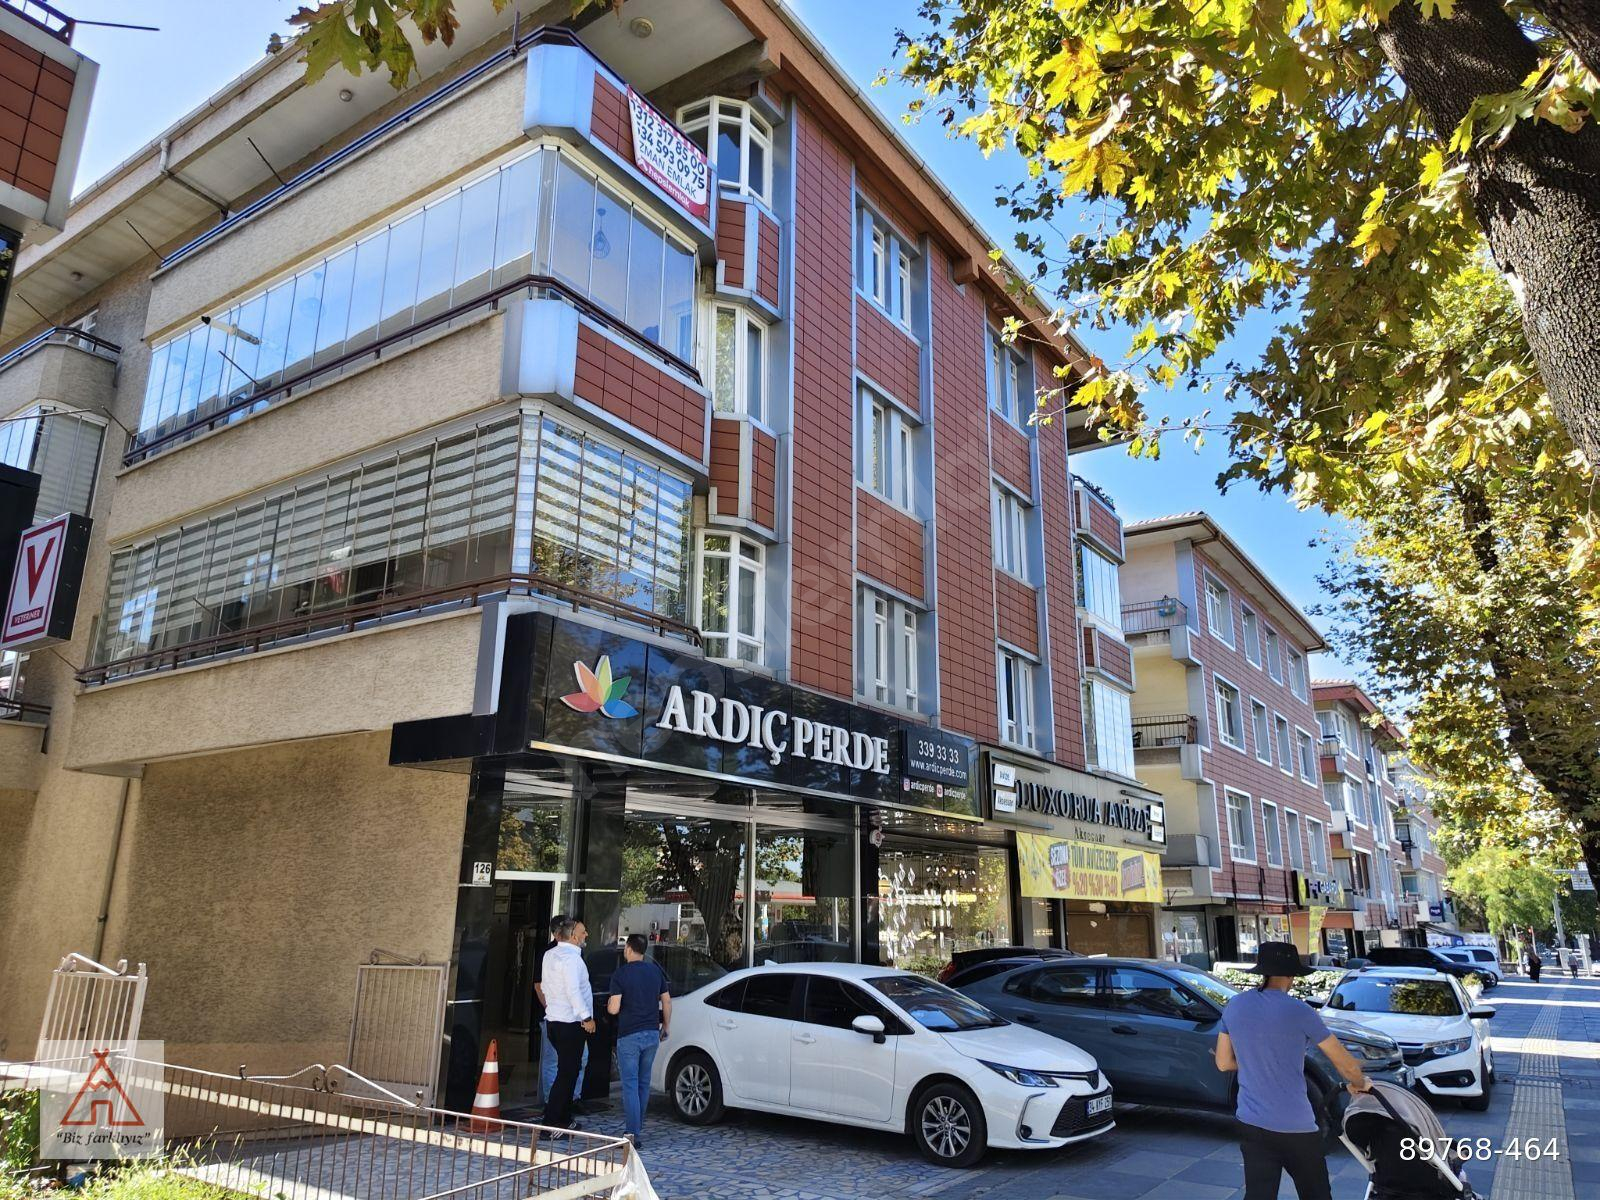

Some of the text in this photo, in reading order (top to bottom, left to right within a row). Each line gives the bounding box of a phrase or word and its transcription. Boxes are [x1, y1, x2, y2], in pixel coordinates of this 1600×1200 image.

[656, 123, 674, 146] 317
[675, 142, 688, 161] 85
[690, 155, 705, 176] 00
[656, 140, 675, 165] 593
[676, 159, 690, 176] 09
[692, 171, 705, 190] 75
[666, 167, 697, 200] EMLAK
[27, 536, 56, 606] V
[791, 716, 891, 775] PERDE
[918, 740, 959, 764] 339 33 33
[910, 759, 967, 780] www.ardicperde.com
[910, 781, 967, 800] ardicperde ardicperde
[474, 863, 491, 874] 126
